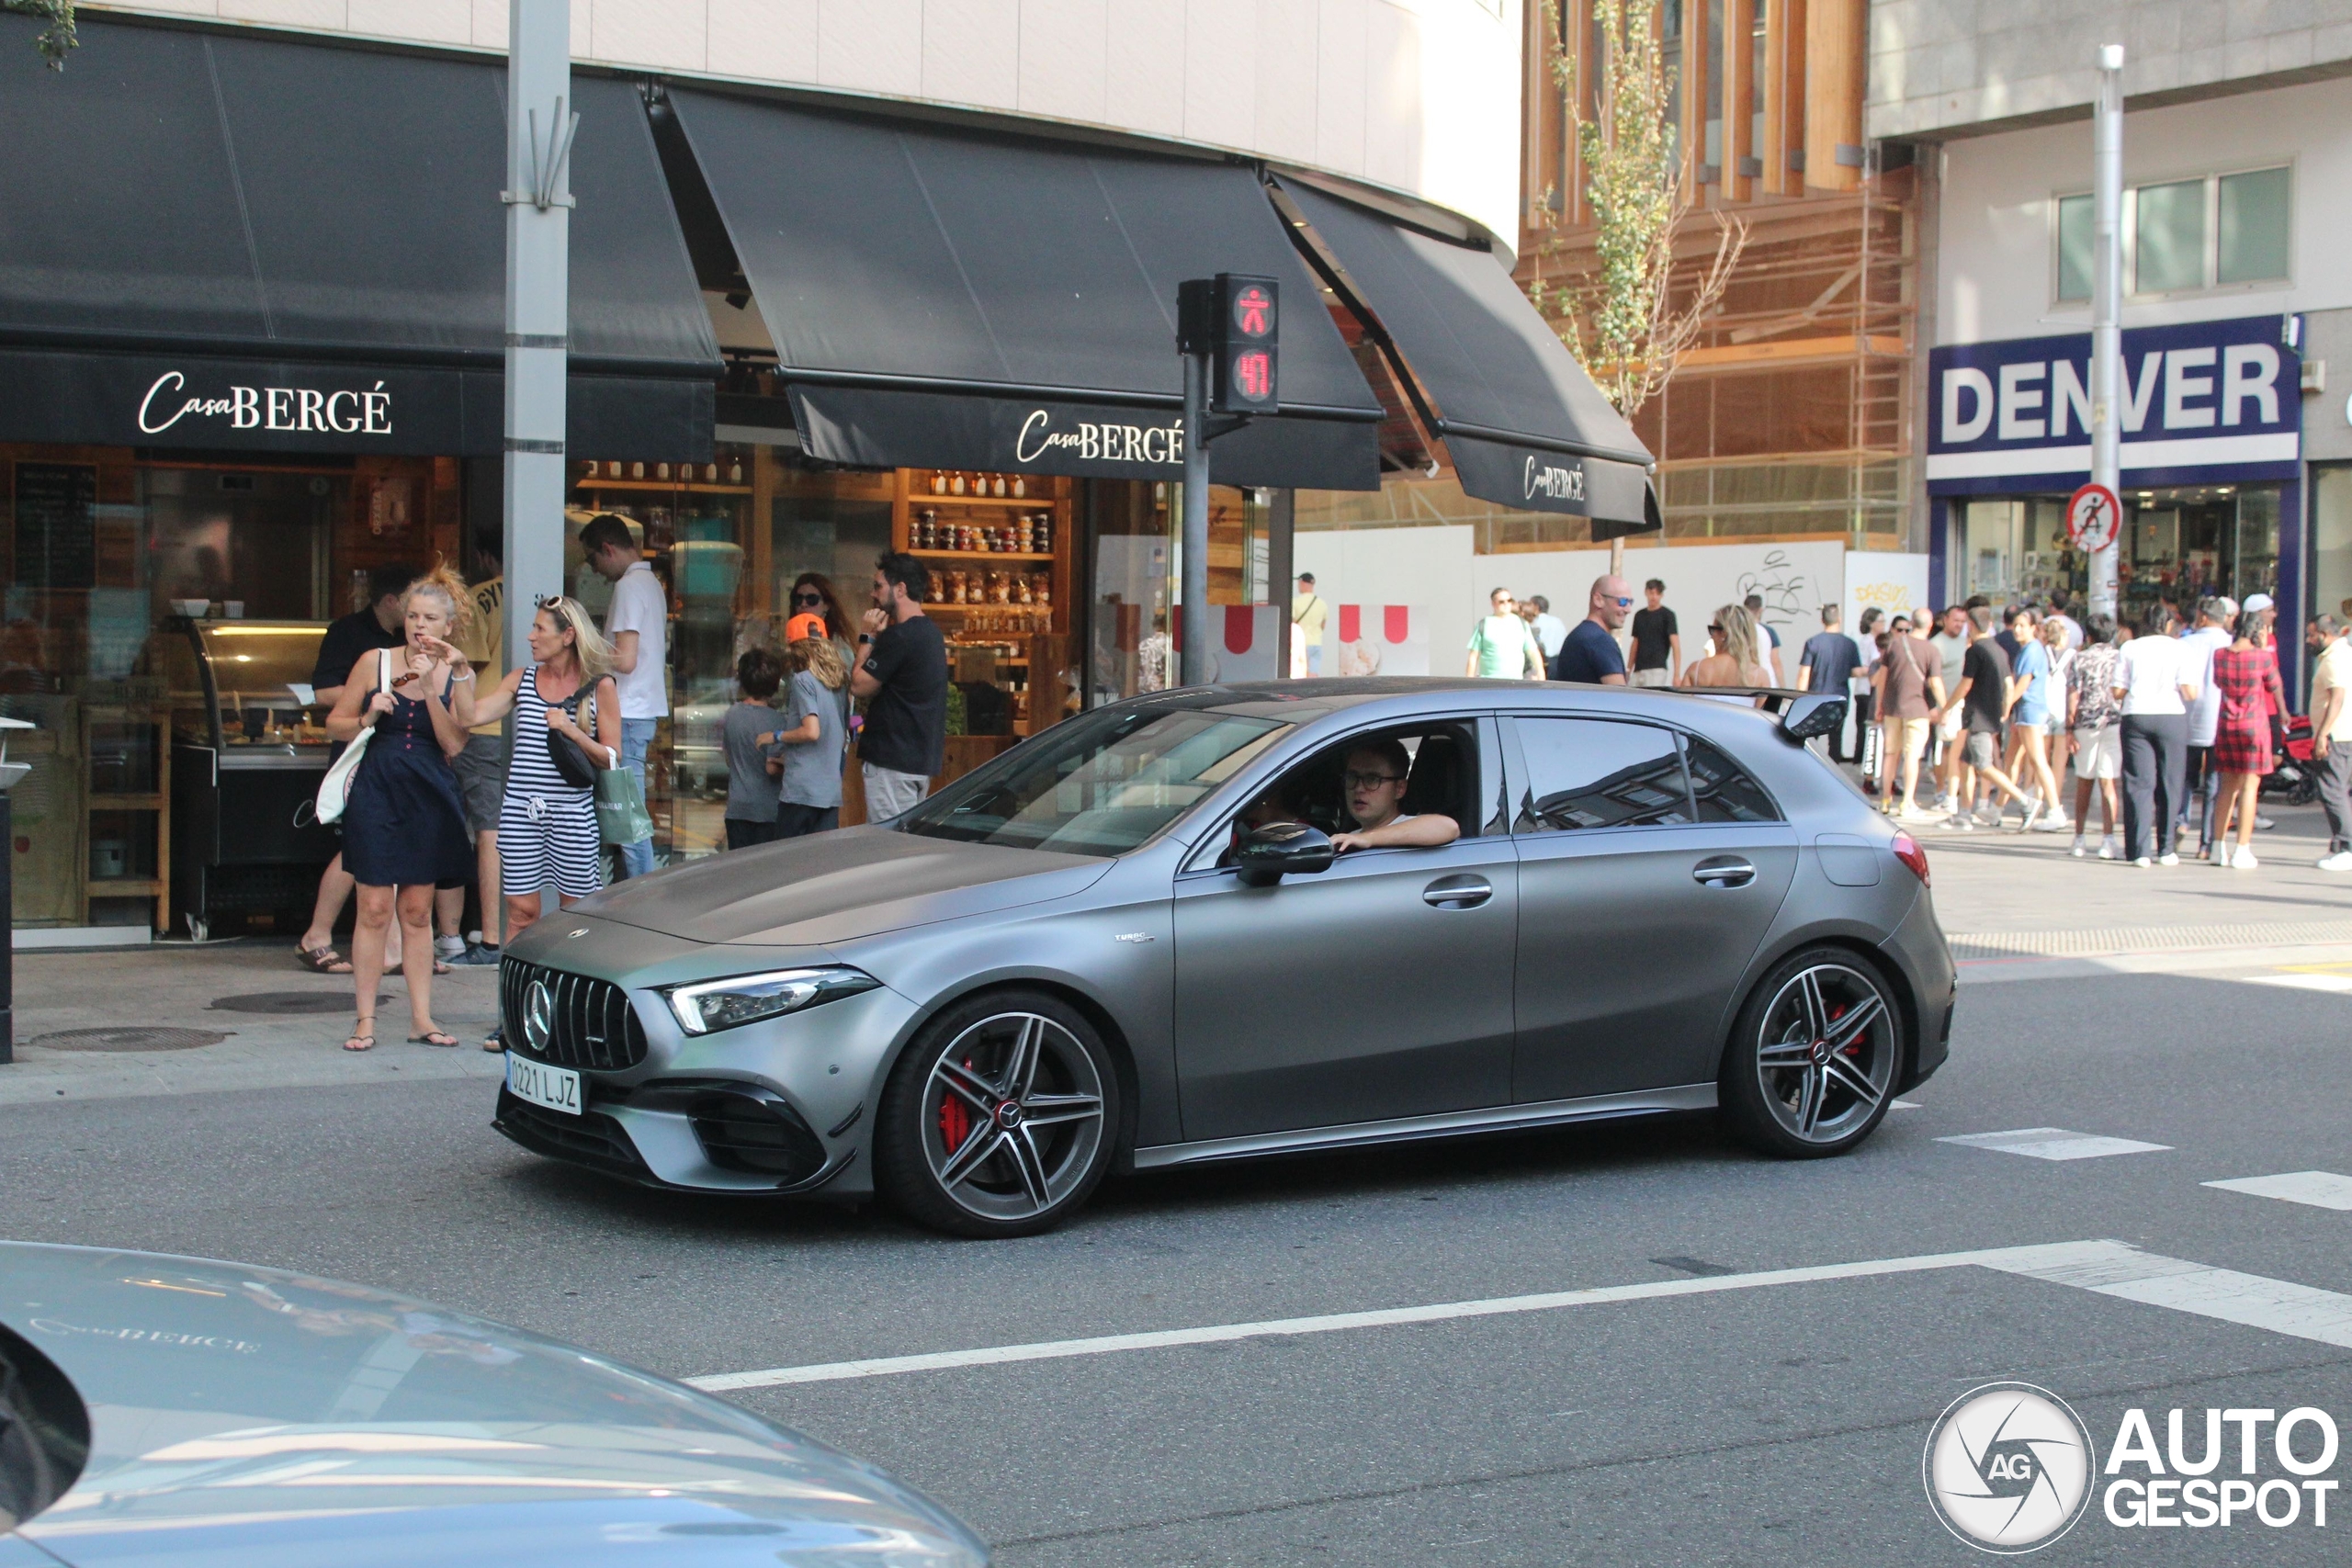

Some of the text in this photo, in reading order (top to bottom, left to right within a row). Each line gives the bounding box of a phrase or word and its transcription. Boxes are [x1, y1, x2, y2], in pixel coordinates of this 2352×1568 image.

[1940, 343, 2280, 444] DENVER
[512, 1060, 576, 1108] 0221 LJZ
